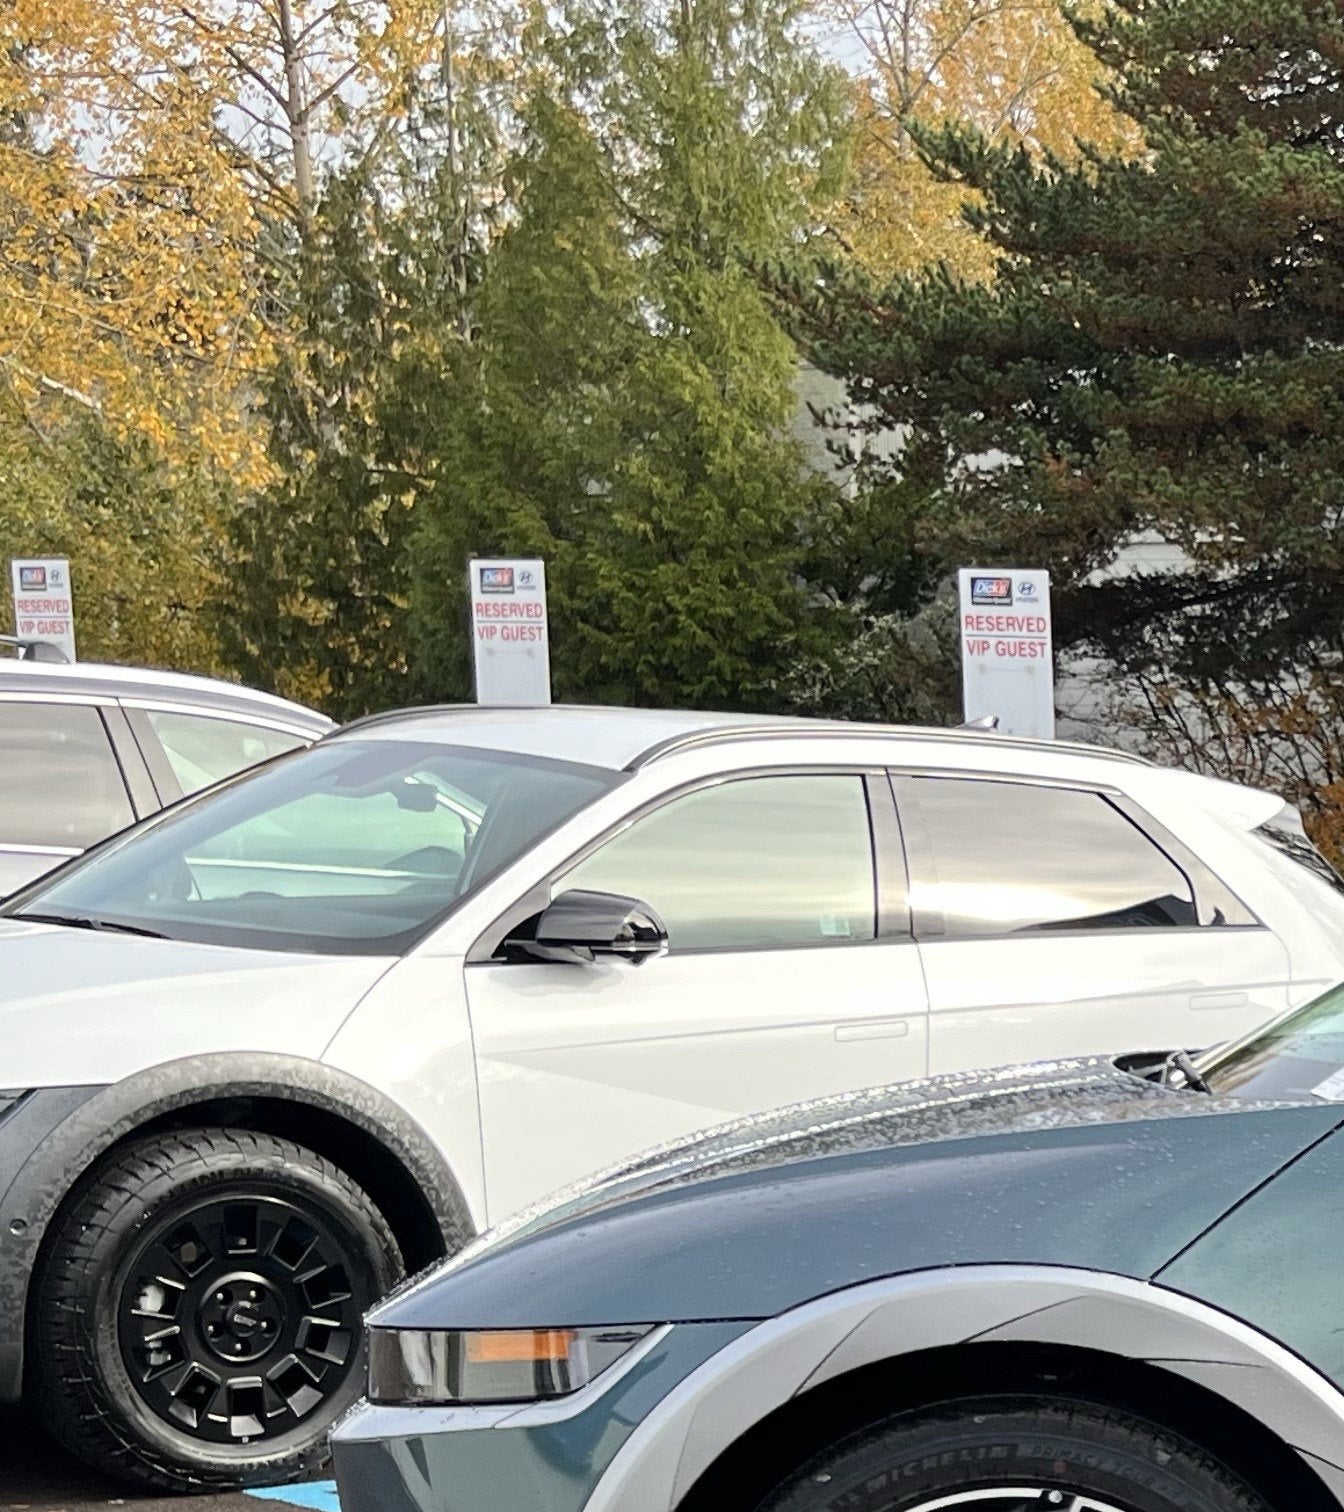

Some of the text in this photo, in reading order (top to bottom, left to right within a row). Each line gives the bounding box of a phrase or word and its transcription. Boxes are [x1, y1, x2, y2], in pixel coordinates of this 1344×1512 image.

[17, 599, 69, 613] RESERVED
[476, 602, 543, 618] RESERVED
[19, 621, 69, 634] VIP GUEST
[965, 615, 1047, 633] RESERVED
[477, 625, 543, 641] VIP GUEST
[966, 640, 1047, 658] VIP GUEST
